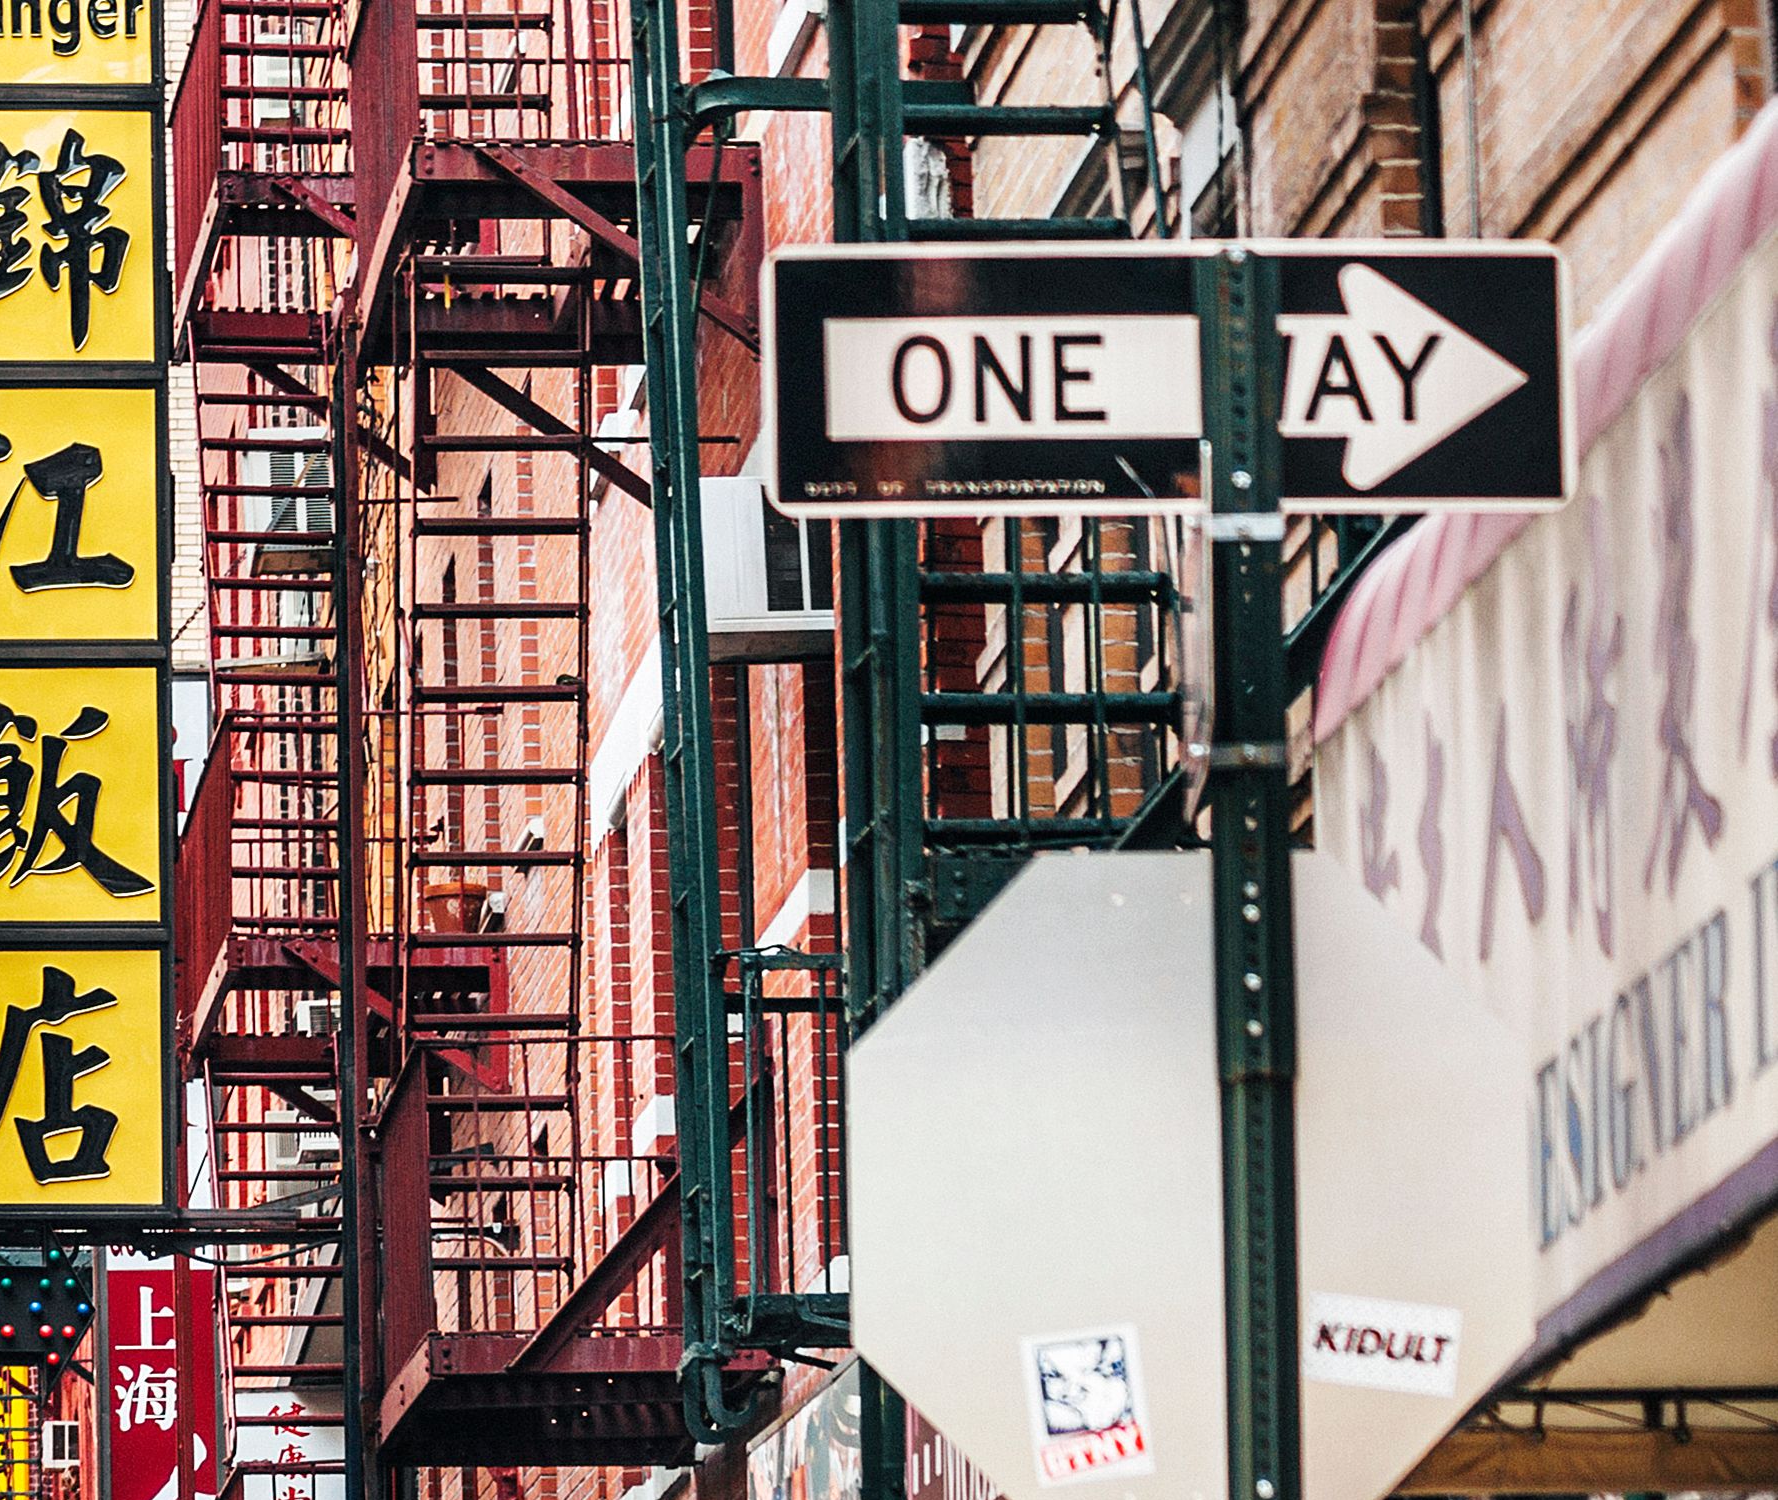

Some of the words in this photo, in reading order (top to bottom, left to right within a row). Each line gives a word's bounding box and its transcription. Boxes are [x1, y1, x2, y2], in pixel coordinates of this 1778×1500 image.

[893, 331, 1109, 425] ONE
[1279, 331, 1444, 423] AY
[1313, 1320, 1448, 1366] KIDULT
